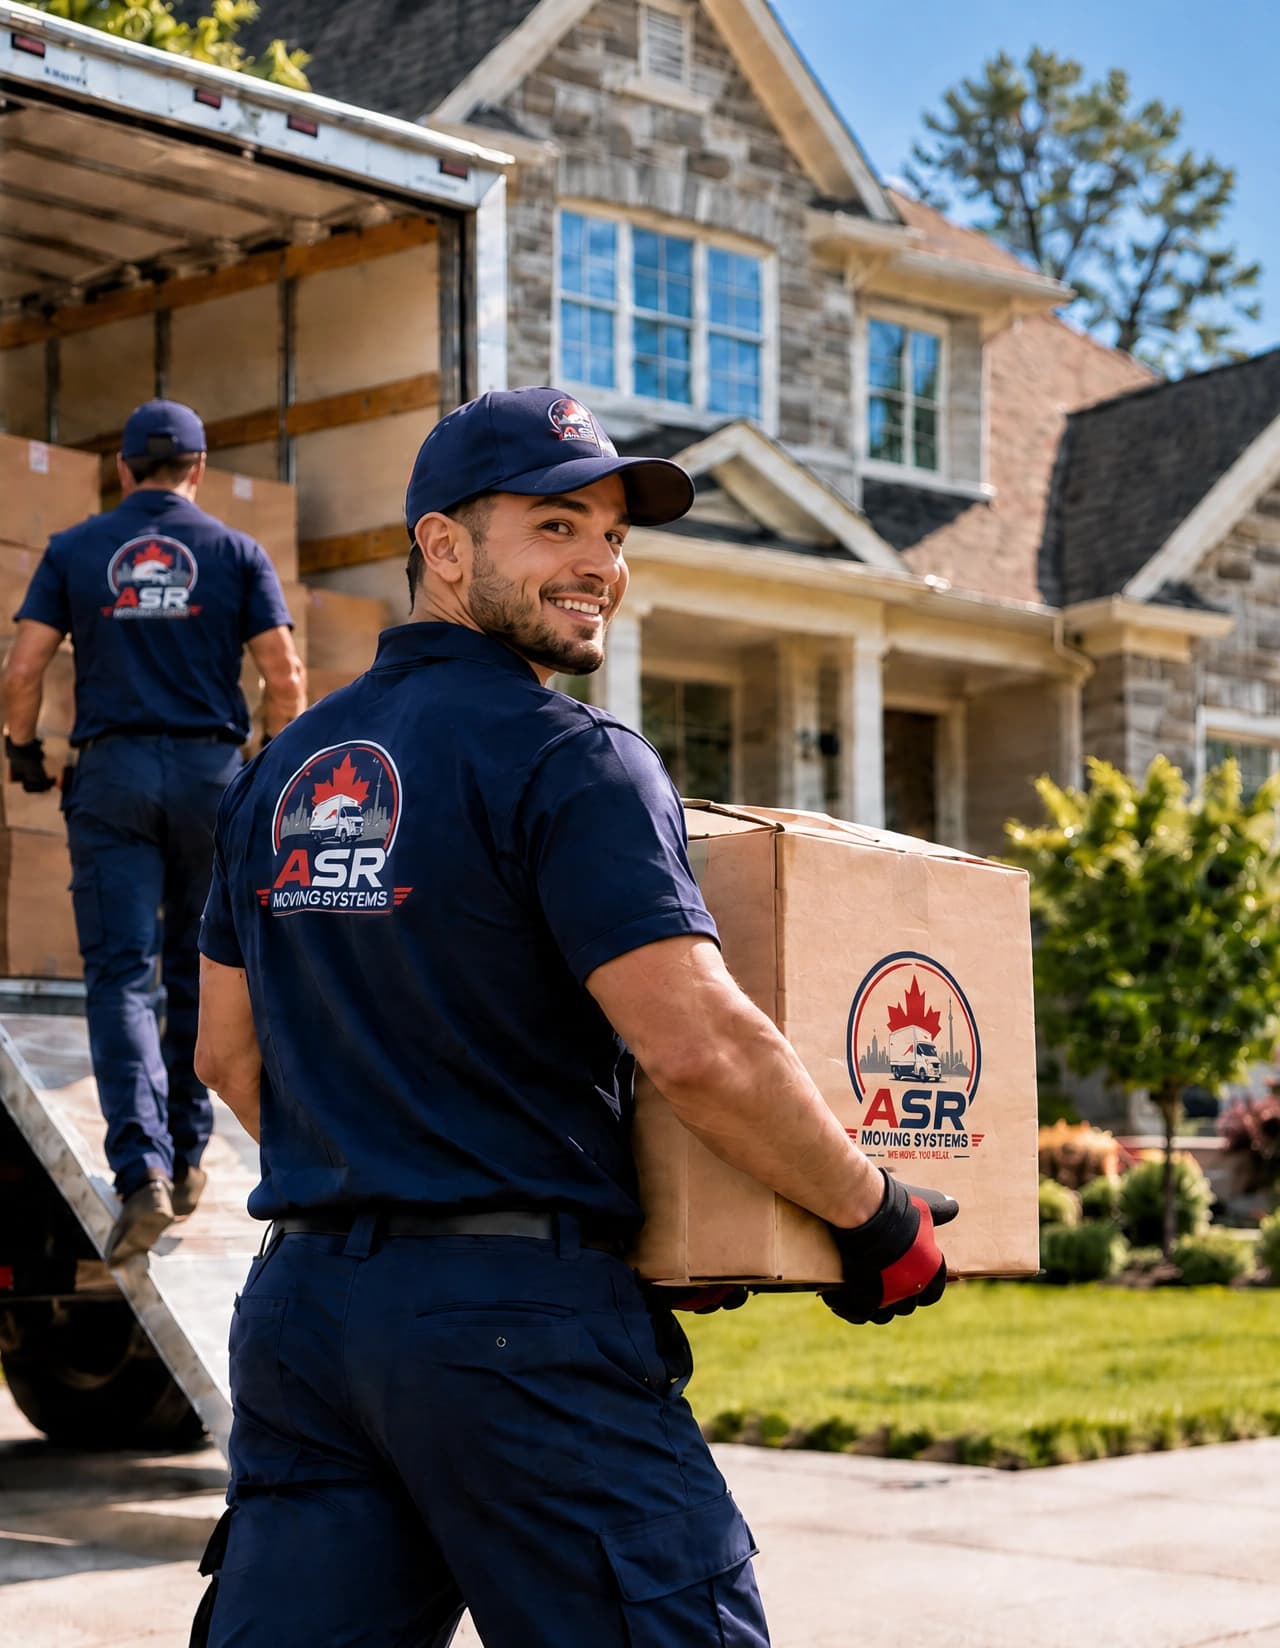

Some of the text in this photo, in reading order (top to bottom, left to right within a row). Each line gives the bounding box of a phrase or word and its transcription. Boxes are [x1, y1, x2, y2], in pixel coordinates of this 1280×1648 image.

[113, 586, 189, 609] ASR
[272, 847, 386, 889] ASR
[273, 890, 388, 908] MOVING SYSTEMS
[862, 1088, 967, 1131] ASR
[861, 1130, 969, 1149] MOVING SYSTEMS
